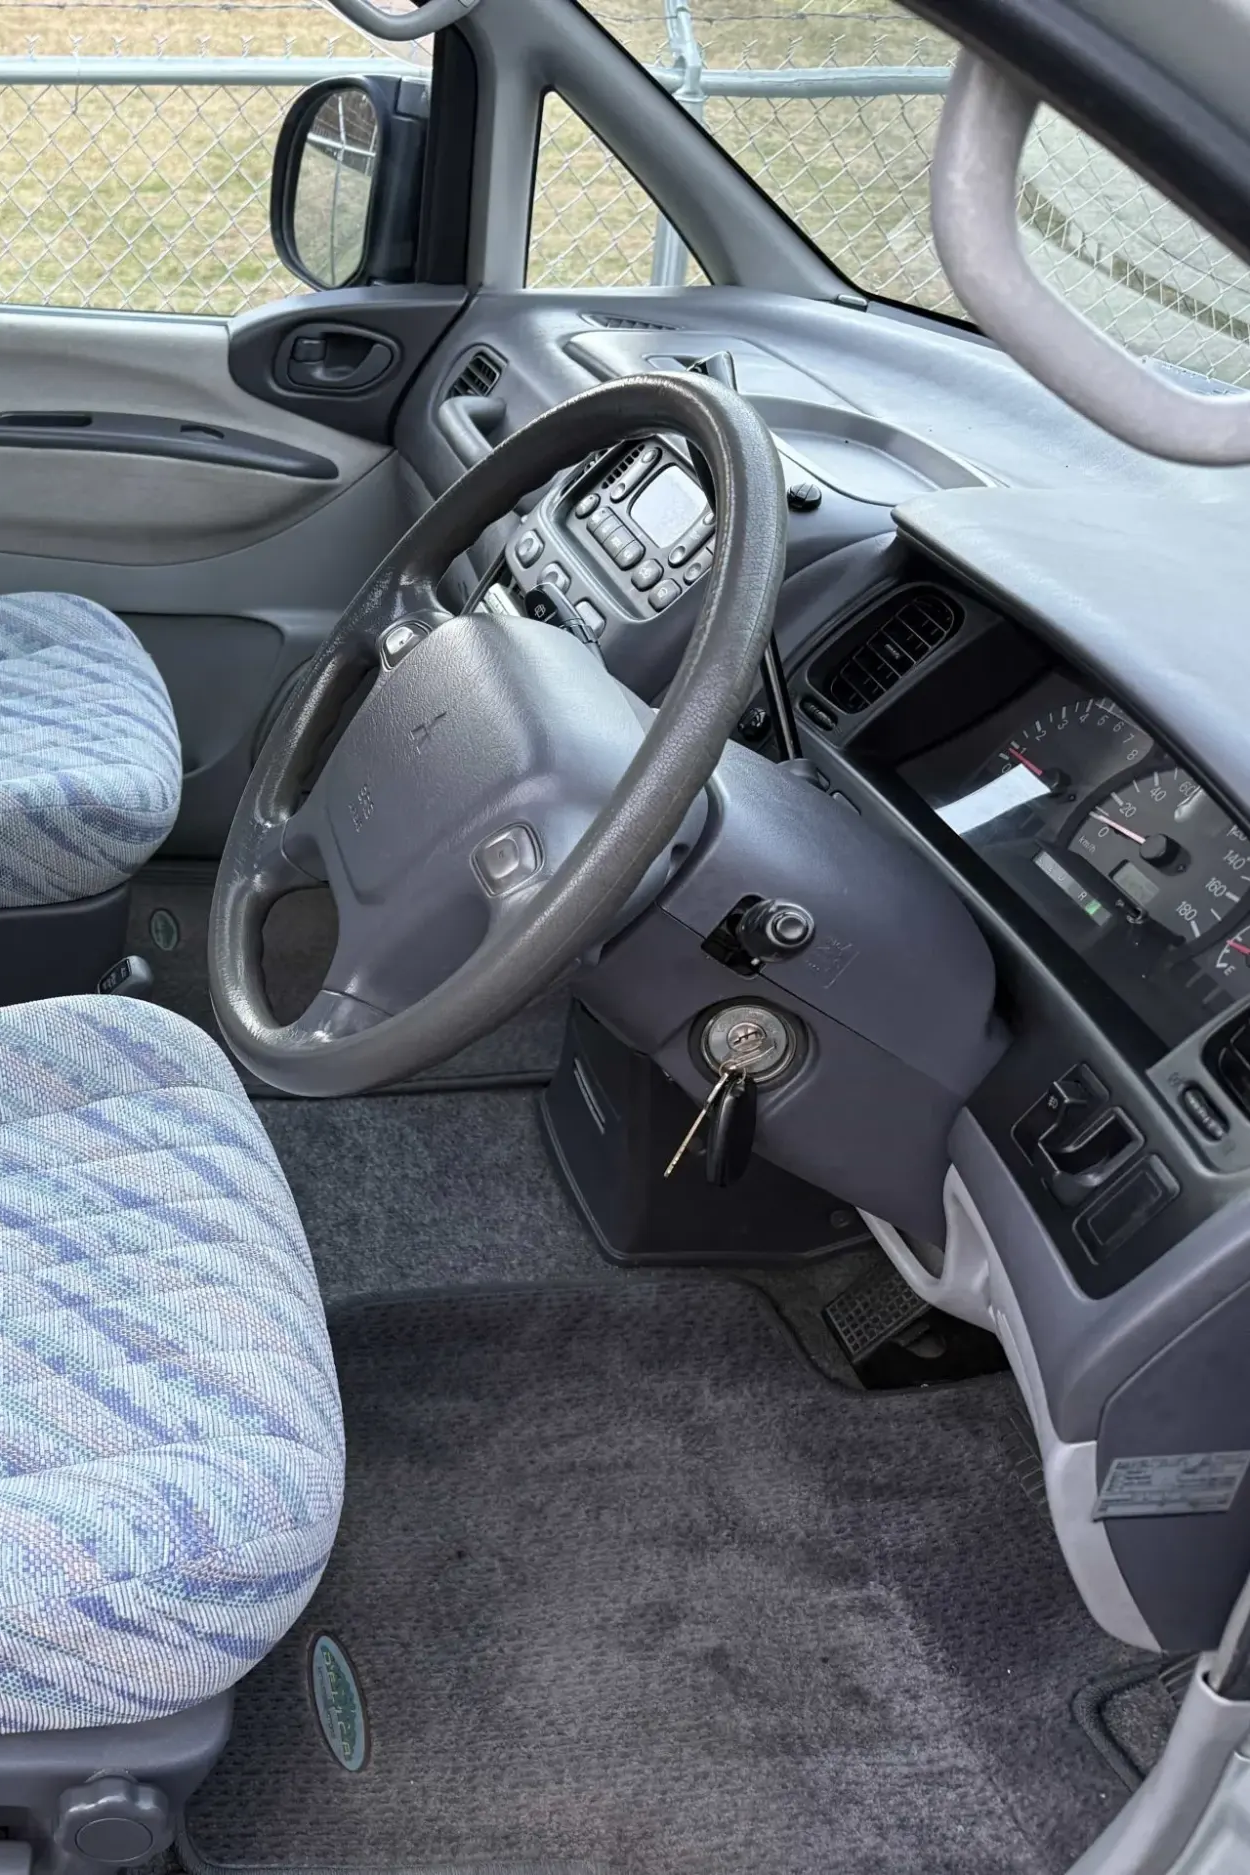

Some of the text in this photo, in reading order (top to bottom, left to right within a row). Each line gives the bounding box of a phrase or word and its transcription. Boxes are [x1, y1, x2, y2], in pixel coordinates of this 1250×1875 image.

[1057, 719, 1069, 730] 3
[1035, 730, 1046, 741] 2
[1123, 733, 1134, 743] 7
[1126, 749, 1138, 761] 8
[1150, 787, 1167, 802] 40
[1119, 802, 1136, 818] 20
[1098, 827, 1109, 838] 0
[1223, 850, 1246, 870] 140
[1205, 877, 1227, 897] 160
[1077, 891, 1088, 902] R
[1176, 900, 1198, 921] 180
[1223, 965, 1236, 976] E
